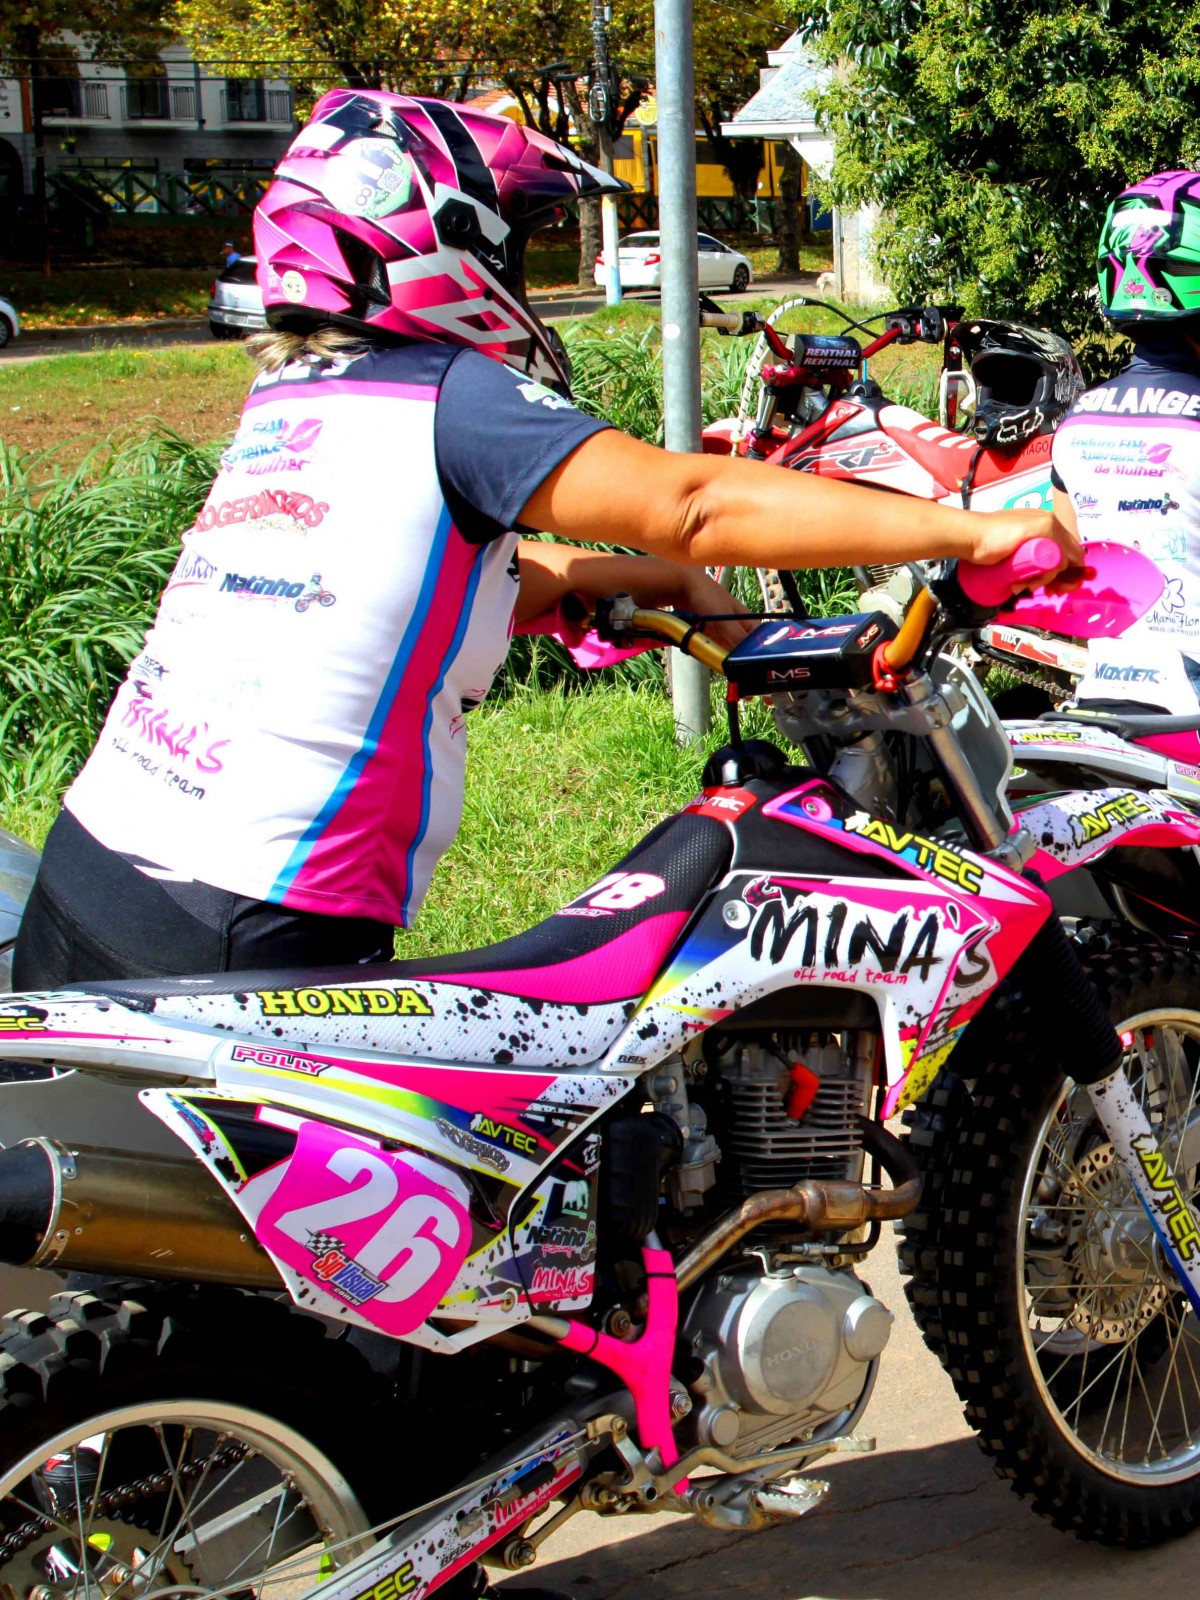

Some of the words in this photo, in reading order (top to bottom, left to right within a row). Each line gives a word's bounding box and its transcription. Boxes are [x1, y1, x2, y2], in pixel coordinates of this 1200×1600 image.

[803, 357, 856, 367] RENTHAL
[806, 348, 860, 358] RENTHAL
[1115, 464, 1167, 478] Mulher
[1118, 498, 1162, 513] Natinho
[219, 572, 306, 598] Natinho
[1175, 612, 1200, 628] Flor
[121, 698, 231, 774] MINA'S
[1022, 731, 1082, 744] AVTEC
[163, 767, 207, 800] team
[1082, 793, 1150, 840] AVTEC
[860, 819, 985, 895] AVTEC
[750, 897, 1000, 989] MINA'S
[794, 968, 817, 981] off
[823, 969, 858, 983] road
[865, 968, 909, 985] team
[257, 988, 434, 1016] HONDA
[234, 1048, 326, 1075] POLLY
[479, 1118, 538, 1153] AVTEC
[273, 1147, 460, 1304] 26
[525, 1225, 587, 1247] Natinho
